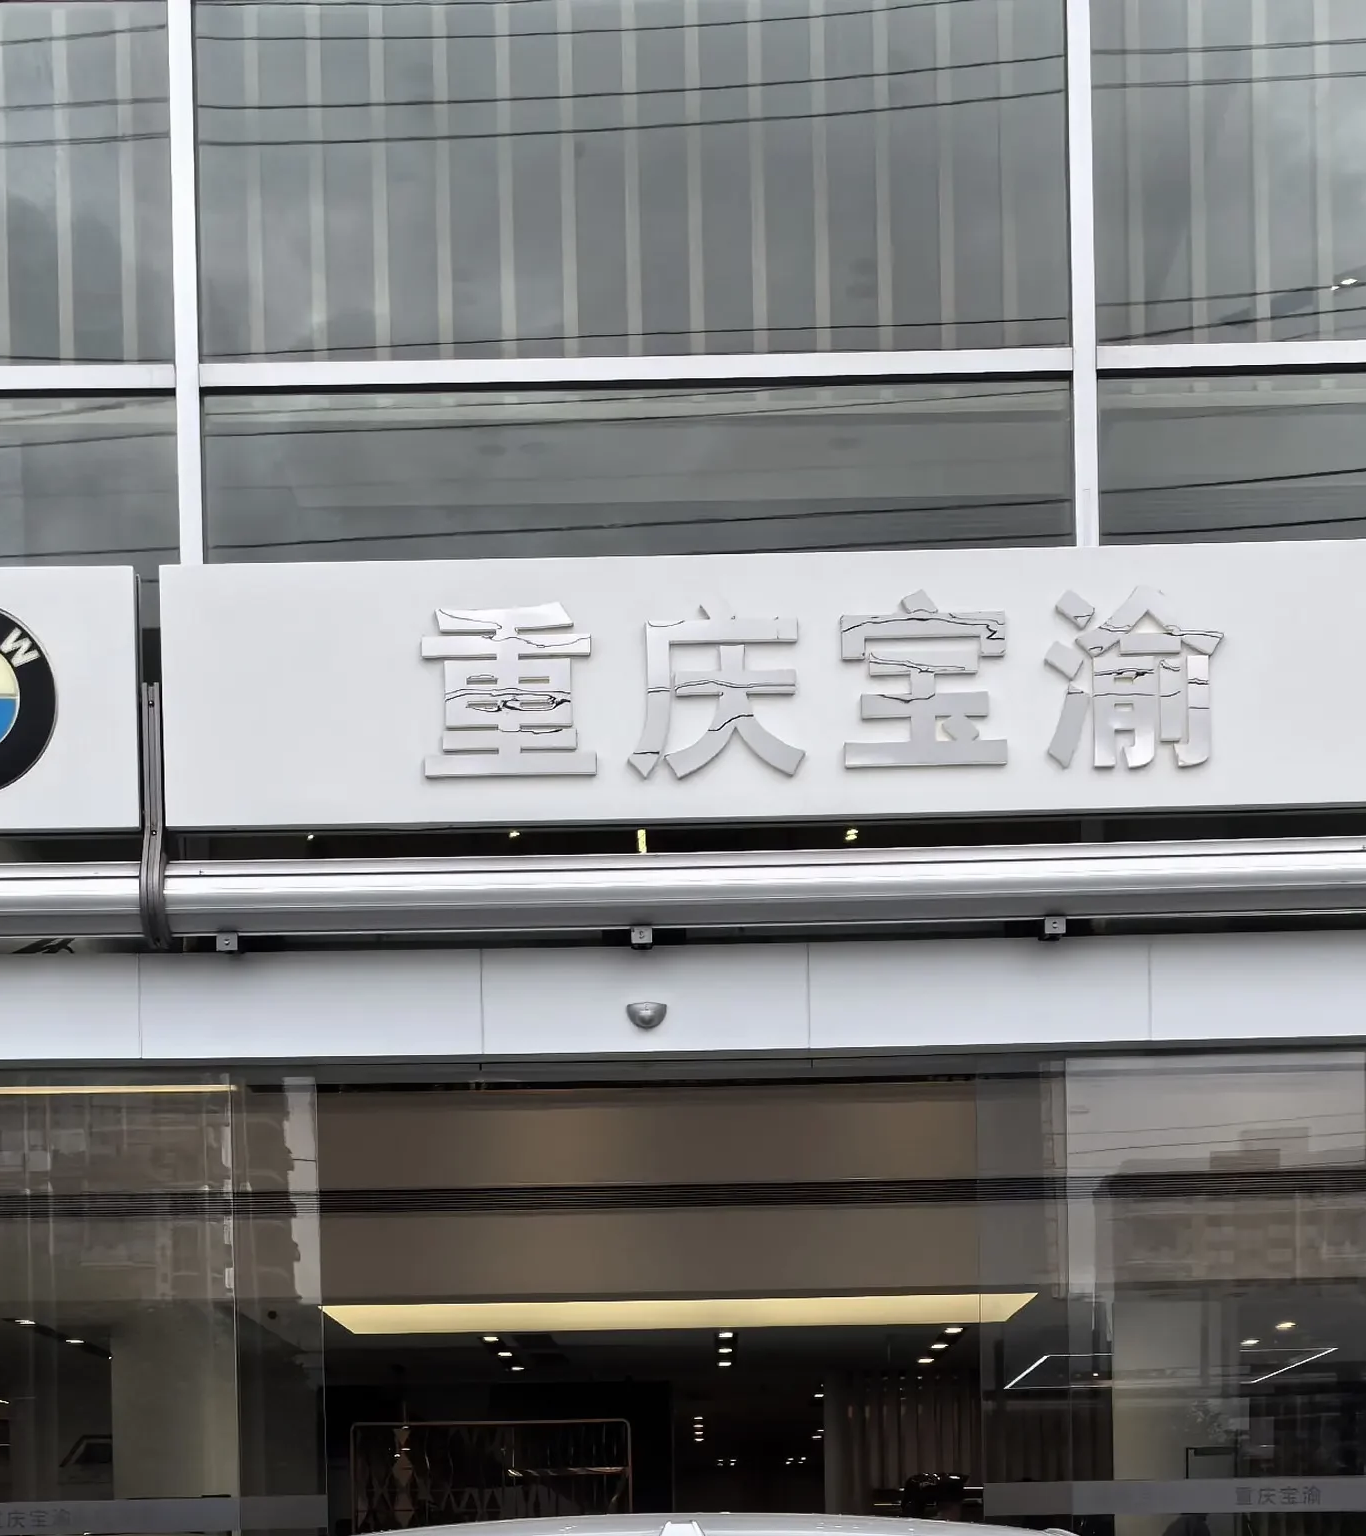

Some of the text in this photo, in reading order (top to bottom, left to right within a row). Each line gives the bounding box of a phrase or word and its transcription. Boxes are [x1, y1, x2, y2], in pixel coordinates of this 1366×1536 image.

[420, 585, 1225, 780] 重庆宝渝
[1235, 1485, 1322, 1506] 重庆宝渝
